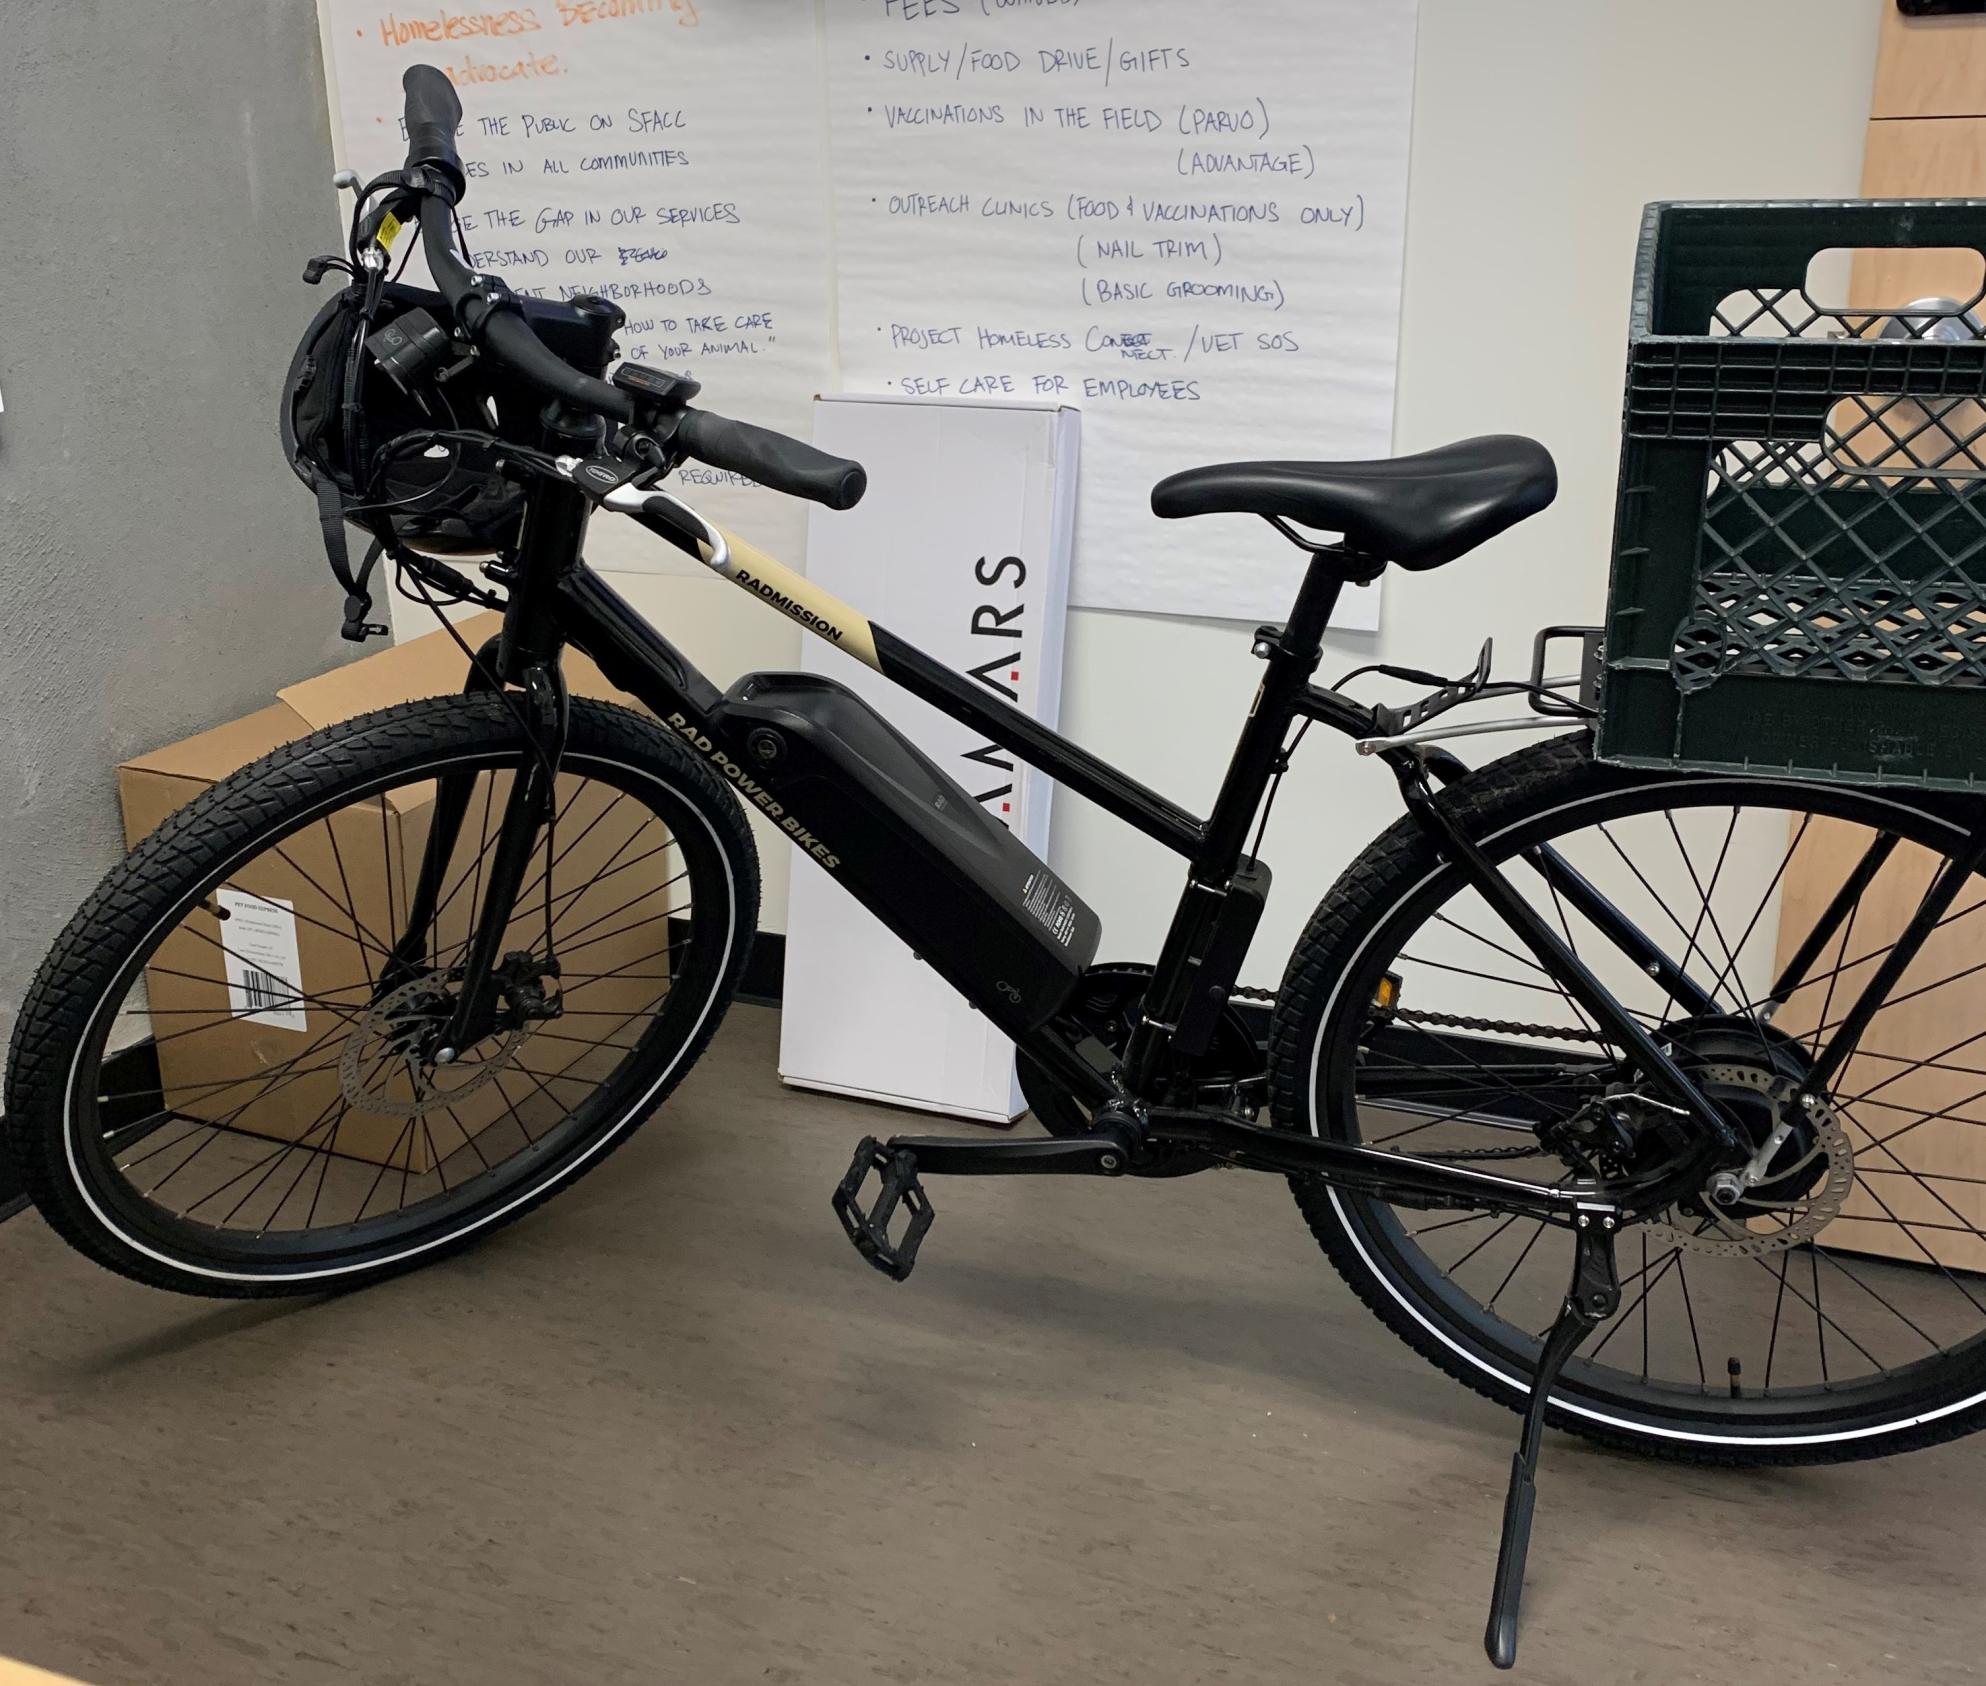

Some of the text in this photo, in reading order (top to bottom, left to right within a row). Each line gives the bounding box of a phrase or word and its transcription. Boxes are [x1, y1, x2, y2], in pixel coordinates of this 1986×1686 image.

[476, 116, 511, 136] THE
[589, 114, 613, 131] ON
[884, 104, 1005, 129] VACCINATIONS
[1024, 106, 1044, 127] IN
[1054, 106, 1090, 129] THE
[1102, 107, 1162, 132] FIELD
[502, 159, 524, 175] IN
[543, 158, 569, 174] ALL
[1177, 144, 1315, 180] (ADVANTAGE)
[485, 209, 526, 229] THE
[534, 207, 575, 234] GAP
[584, 210, 601, 226] IN
[610, 206, 647, 226] OUR
[656, 202, 741, 225] SERVICES
[889, 193, 969, 217] OUTREACH
[981, 198, 1054, 219] CLINICS
[1142, 201, 1280, 223] VACCINATIONS
[1300, 194, 1364, 232] ONLY)
[565, 247, 602, 265] OUR
[624, 312, 773, 335] HOW TO TAKE CARE
[890, 323, 961, 350] PROJECT
[977, 326, 1072, 350] HOMELESS
[1256, 331, 1300, 352] SOS
[658, 342, 693, 361] YOUR
[900, 374, 1201, 401] SELF CARE FOR EMPLOYEES
[679, 469, 763, 487] REQUIRE
[735, 568, 844, 641] RADMISSION
[668, 712, 841, 870] RAD POWER BIKES
